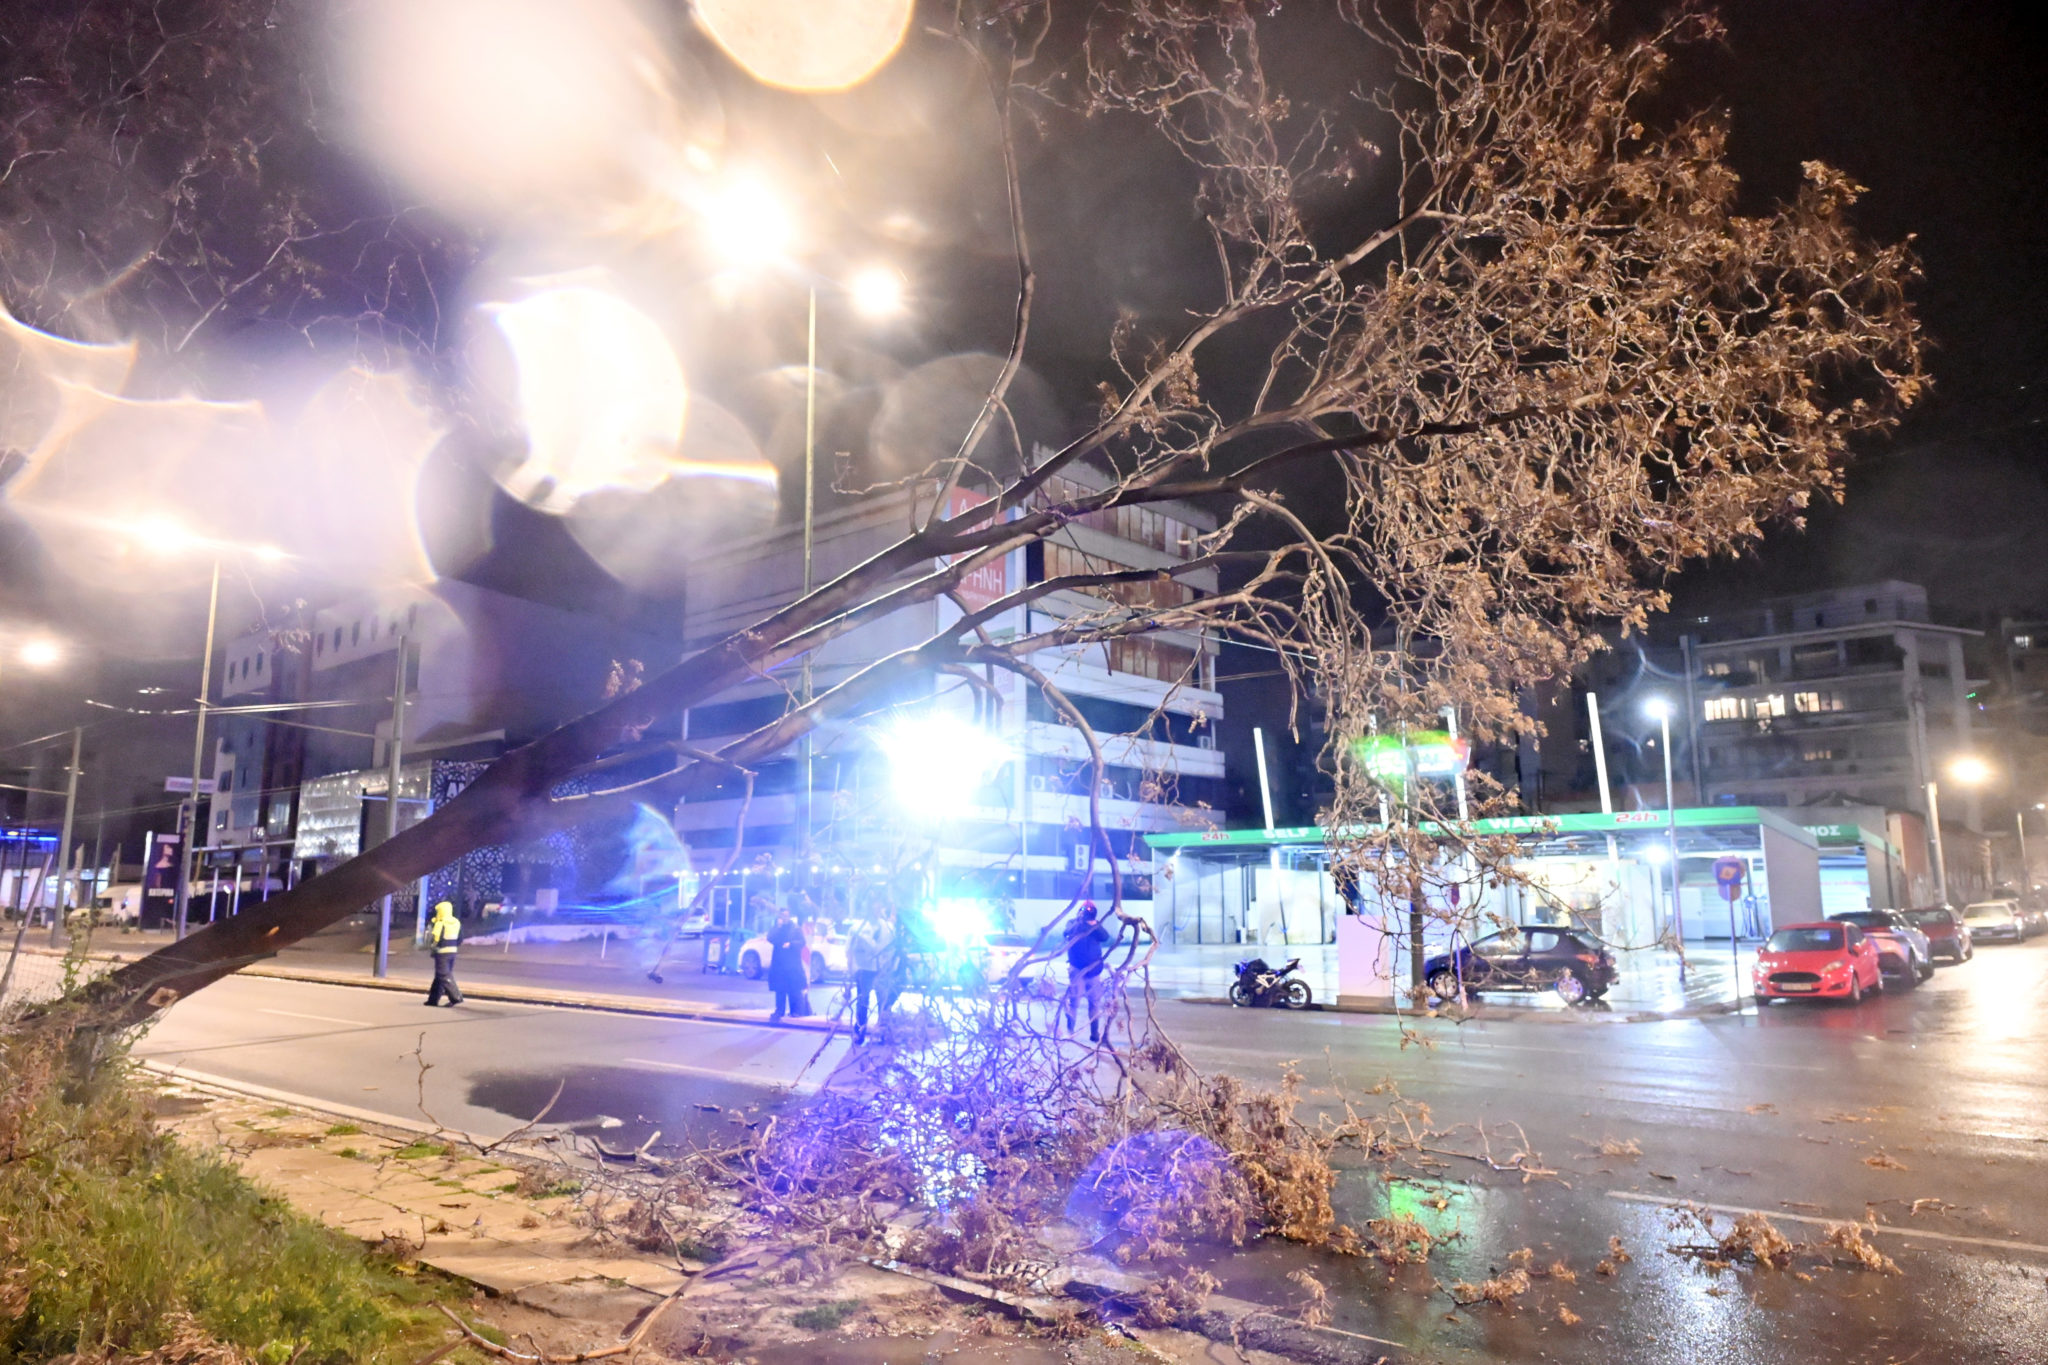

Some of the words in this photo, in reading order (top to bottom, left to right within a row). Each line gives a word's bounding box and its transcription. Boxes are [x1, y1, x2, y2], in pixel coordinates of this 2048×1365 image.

[1201, 831, 1230, 842] 24h
[1262, 828, 1310, 839] SELF
[1615, 812, 1659, 823] 24h
